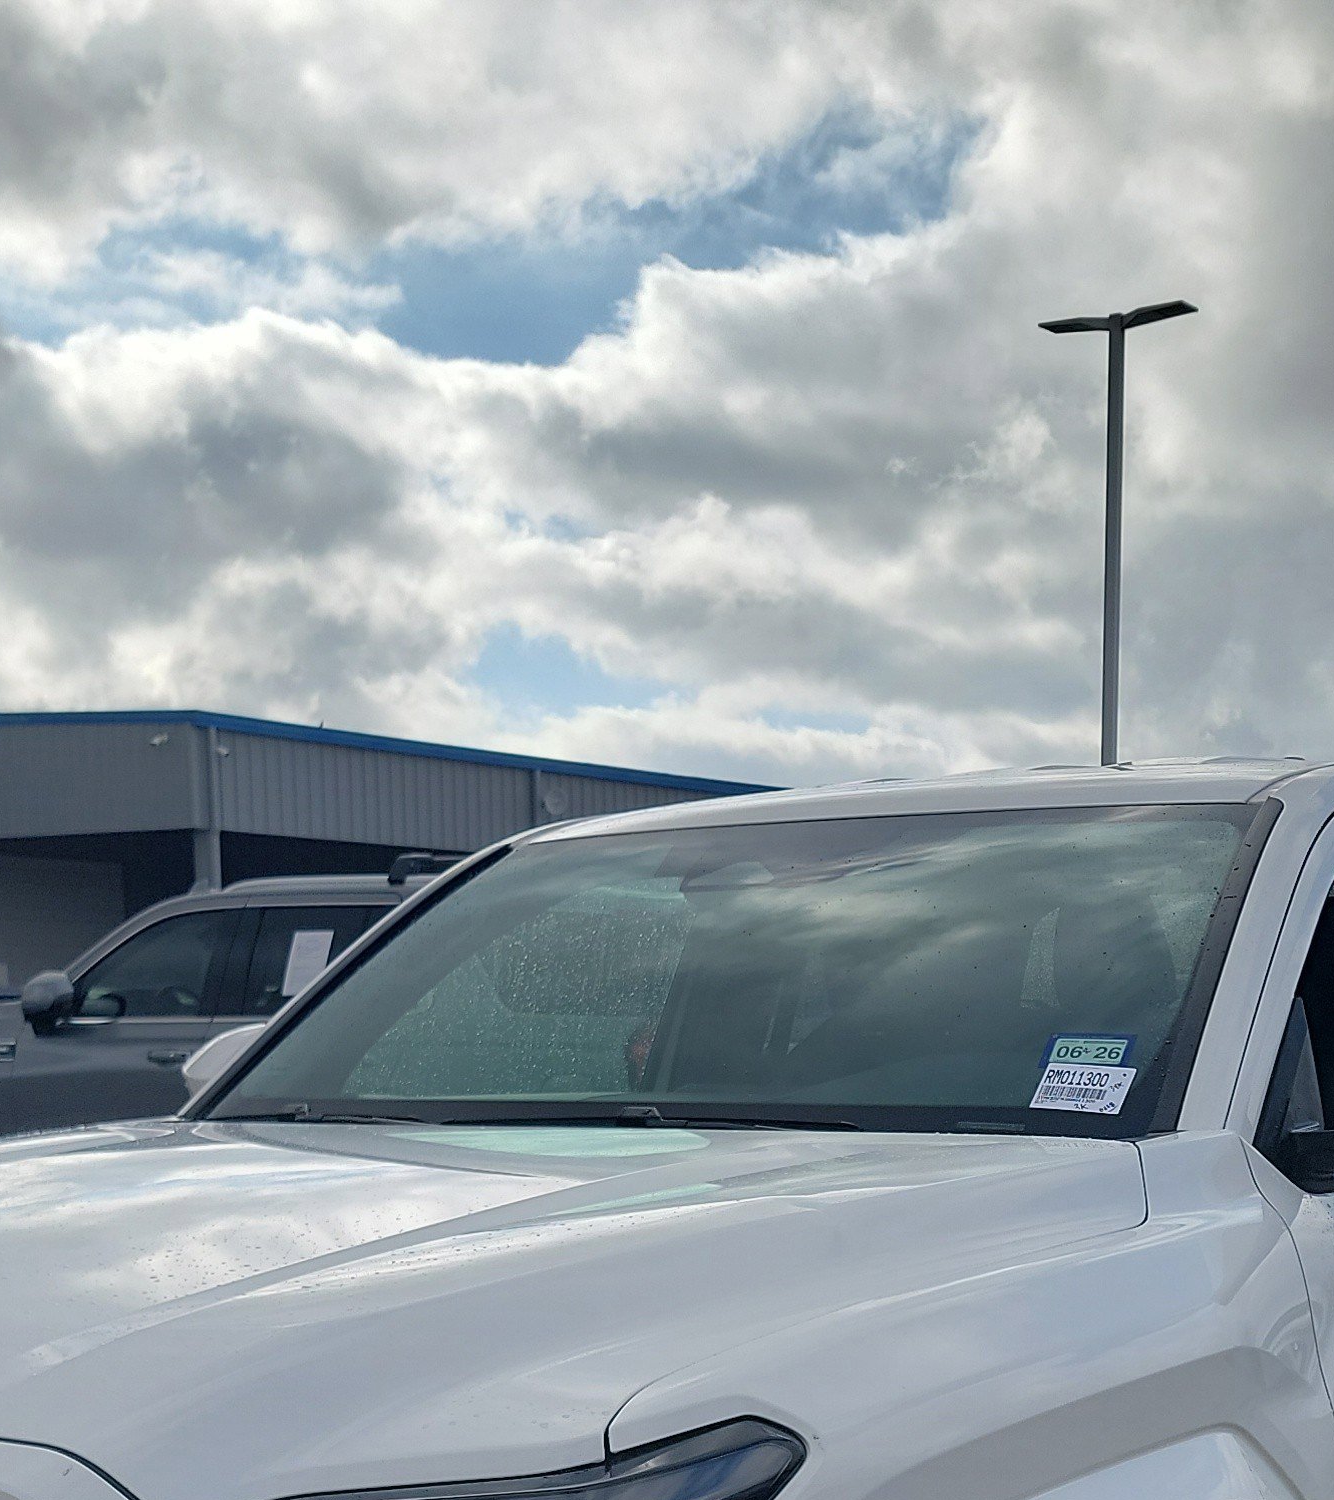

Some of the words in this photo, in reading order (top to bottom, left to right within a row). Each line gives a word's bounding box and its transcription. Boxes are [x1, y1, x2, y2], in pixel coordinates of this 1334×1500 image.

[1056, 1046, 1083, 1059] 06
[1093, 1046, 1122, 1060] 26
[1044, 1069, 1110, 1088] RM011300
